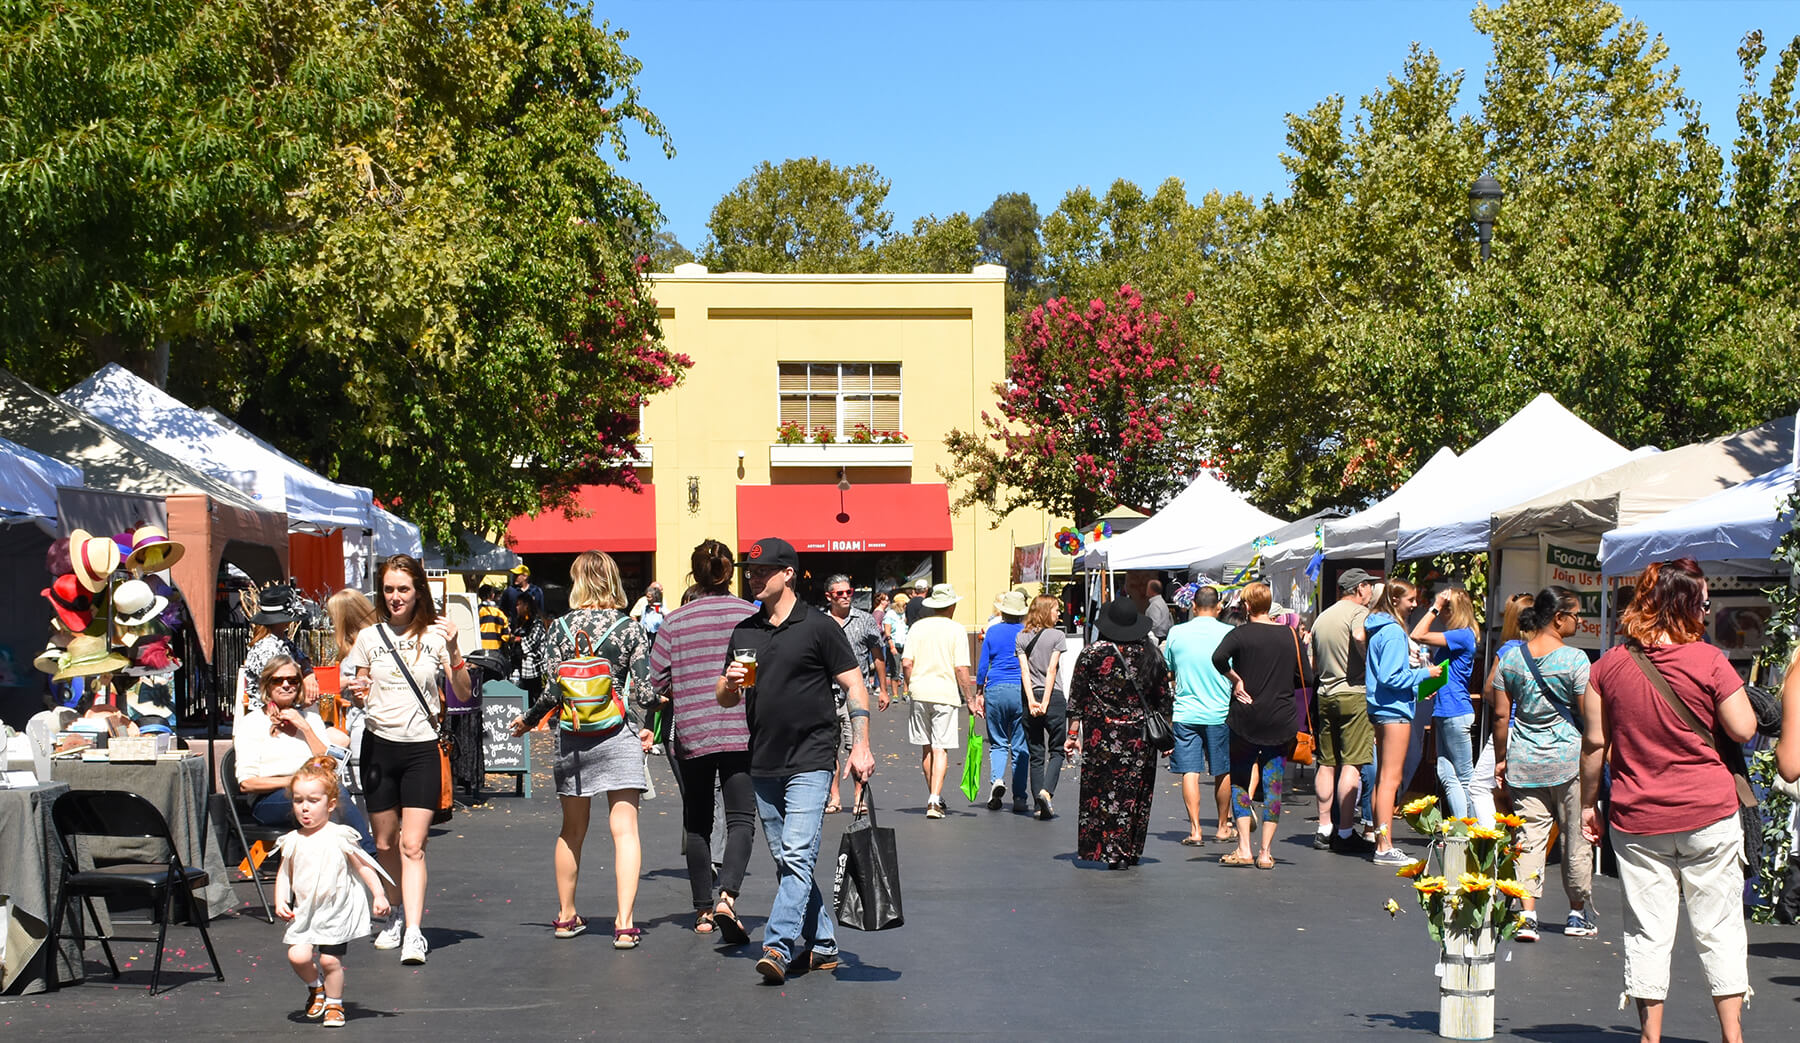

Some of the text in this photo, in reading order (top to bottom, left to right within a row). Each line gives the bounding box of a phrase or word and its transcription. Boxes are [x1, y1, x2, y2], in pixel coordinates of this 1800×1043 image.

[832, 541, 861, 551] ROAM
[1552, 567, 1575, 584] Join
[1579, 572, 1592, 585] Us
[1595, 573, 1614, 586] fr
[372, 640, 433, 660] JAESON
